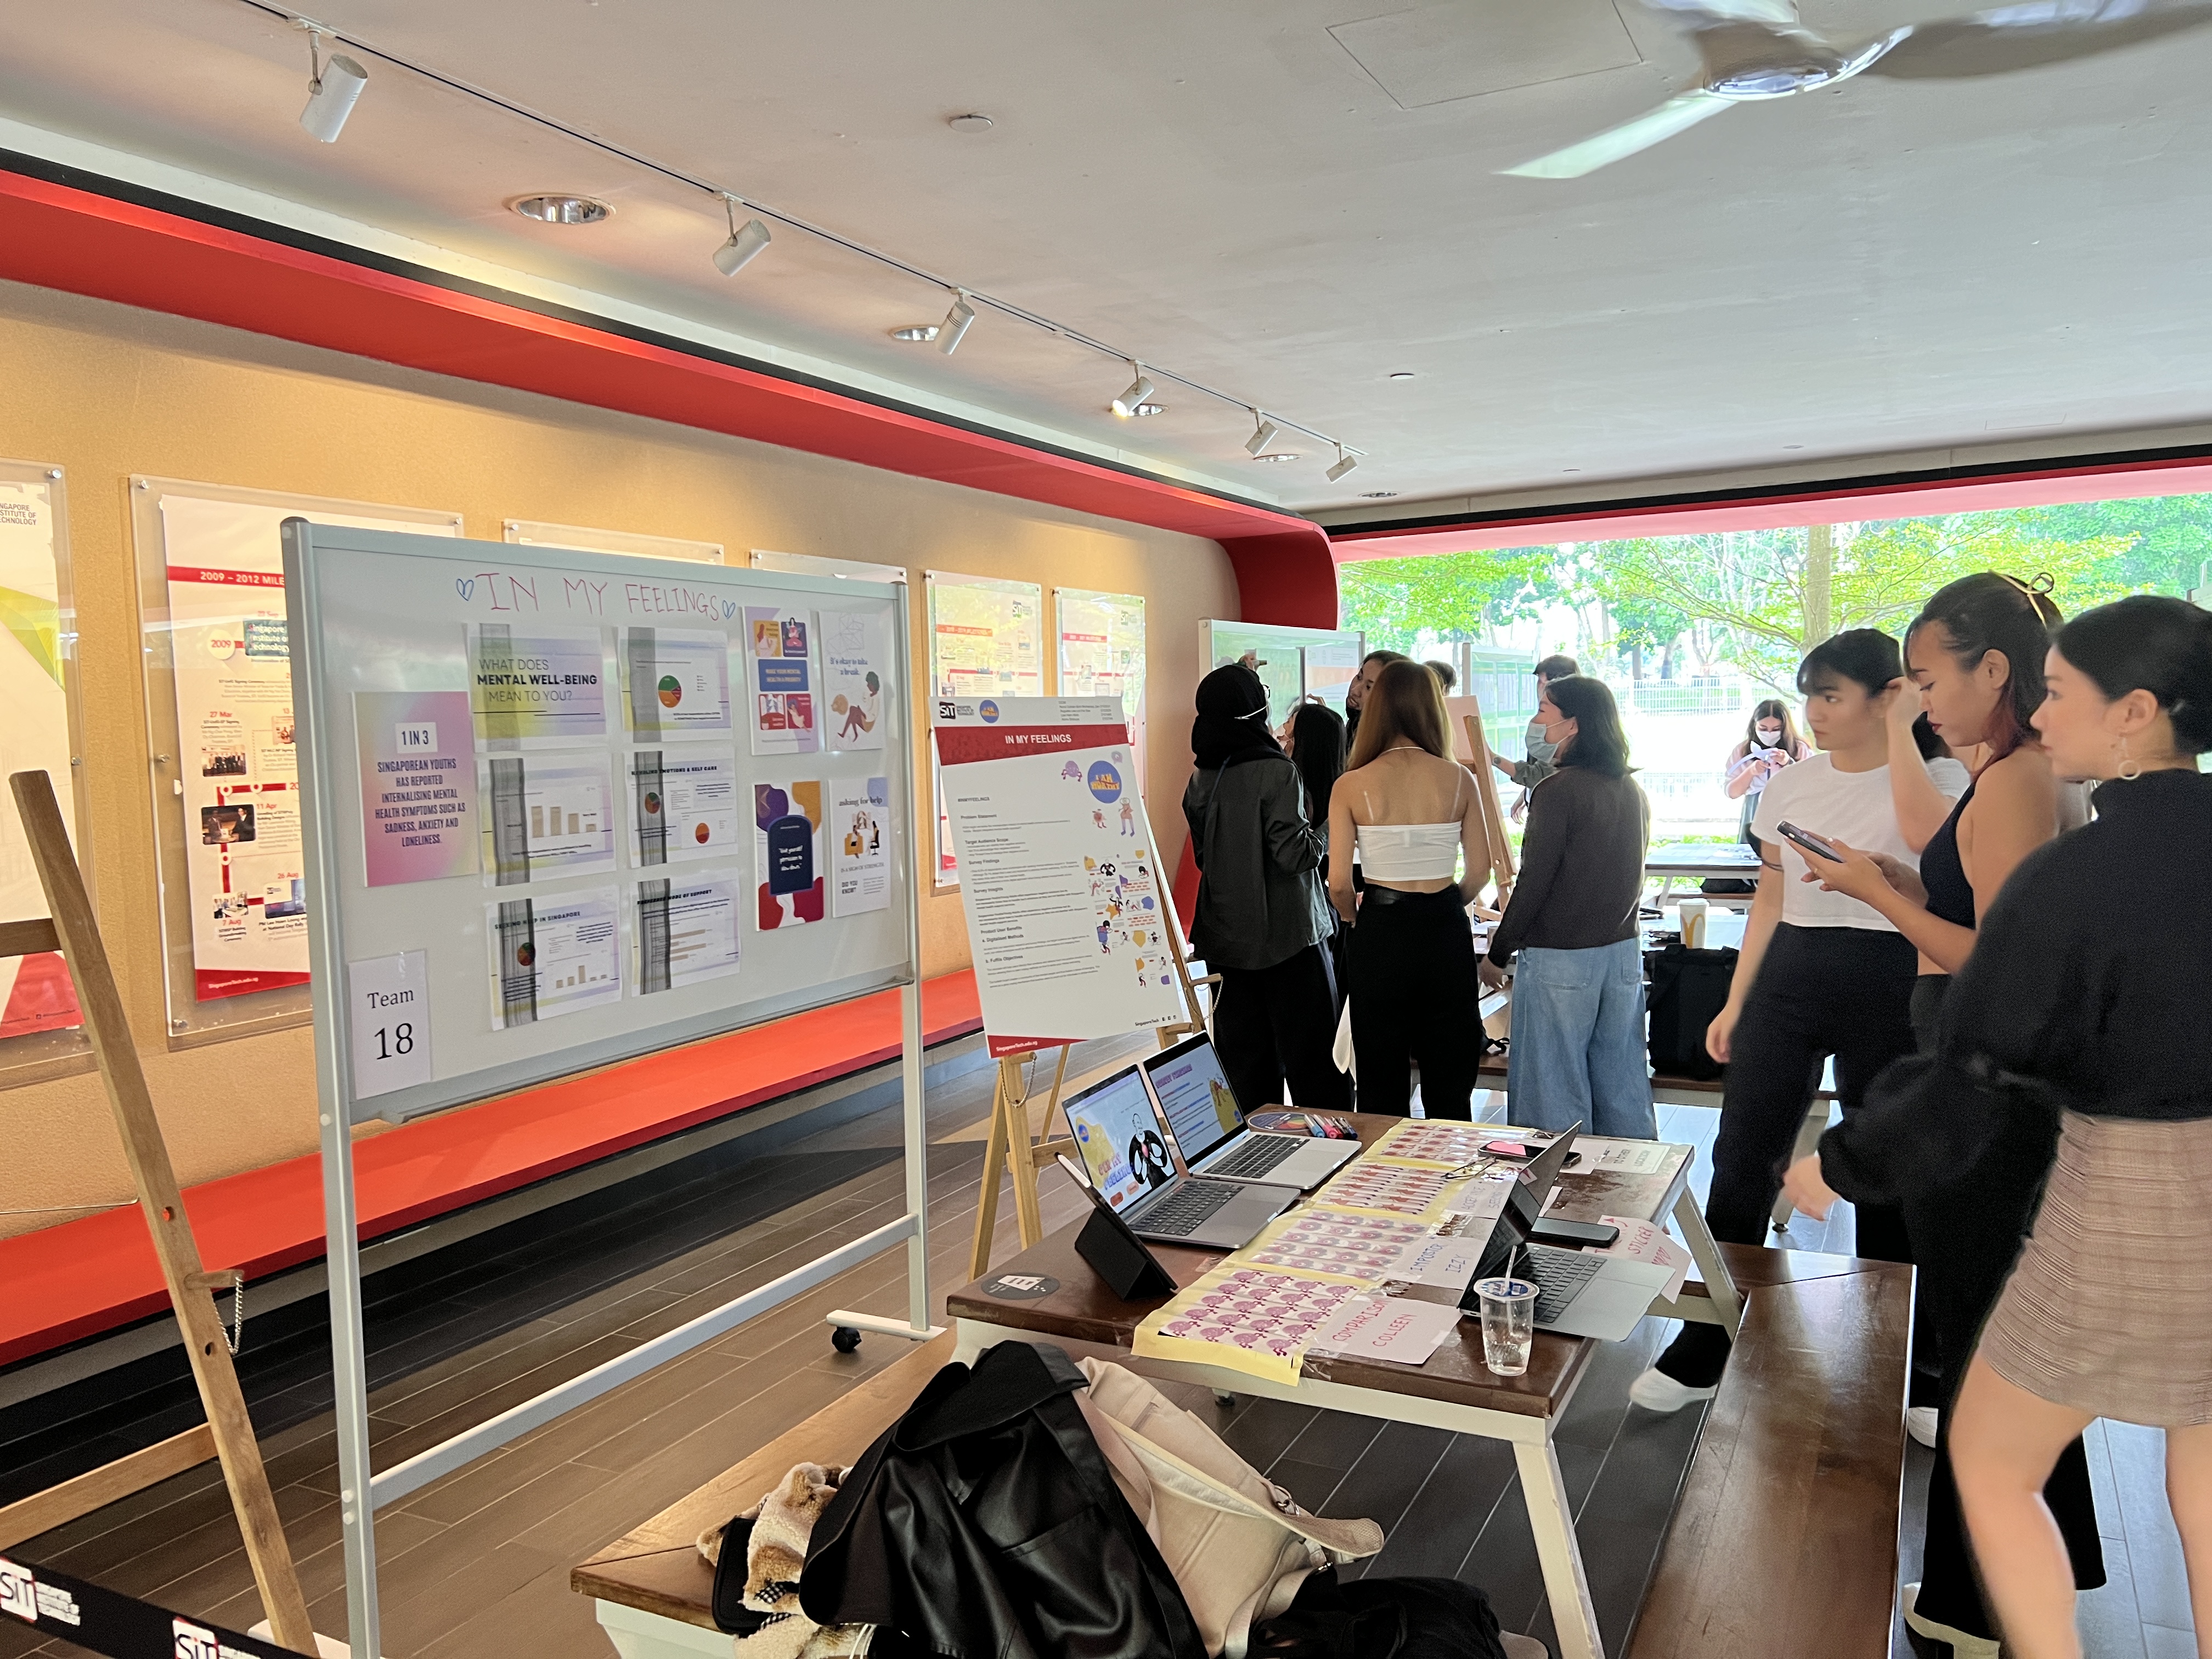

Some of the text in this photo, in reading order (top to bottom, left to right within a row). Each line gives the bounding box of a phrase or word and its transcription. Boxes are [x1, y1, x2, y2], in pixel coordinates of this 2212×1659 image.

[200, 572, 225, 581] 2009
[236, 574, 259, 584] 2012
[475, 573, 720, 622] IN MY FEELINGS
[211, 640, 231, 648] 2009
[479, 659, 549, 670] WHAT DOES
[477, 674, 597, 685] MENTAL WELL-BEING
[488, 690, 572, 702] MEAN TO YOU?
[940, 705, 955, 716] SiT
[402, 730, 430, 745] 1 IN 3
[1005, 734, 1072, 744] IN MY FEELINGS
[377, 758, 456, 772] SINGAPOREAN YOUTHS
[396, 775, 443, 787] HAS REPORTED
[382, 788, 458, 803] INTERNALISING MENTAL
[839, 799, 859, 807] asking
[870, 795, 883, 805] help
[375, 802, 466, 819] HEALTH SYMPTOMS SUCH AS
[384, 817, 459, 833] SADNESS, ANXIETY AND
[548, 911, 580, 921] SINGAPORE
[368, 990, 414, 1008] Team
[375, 1023, 413, 1059] 18
[1628, 1226, 1655, 1254] STICKER
[1410, 1243, 1446, 1272] IMPOSTOR
[1445, 1254, 1472, 1273] IZZY
[1333, 1299, 1393, 1342] COMPARISON
[1373, 1313, 1417, 1347] COLLEEN
